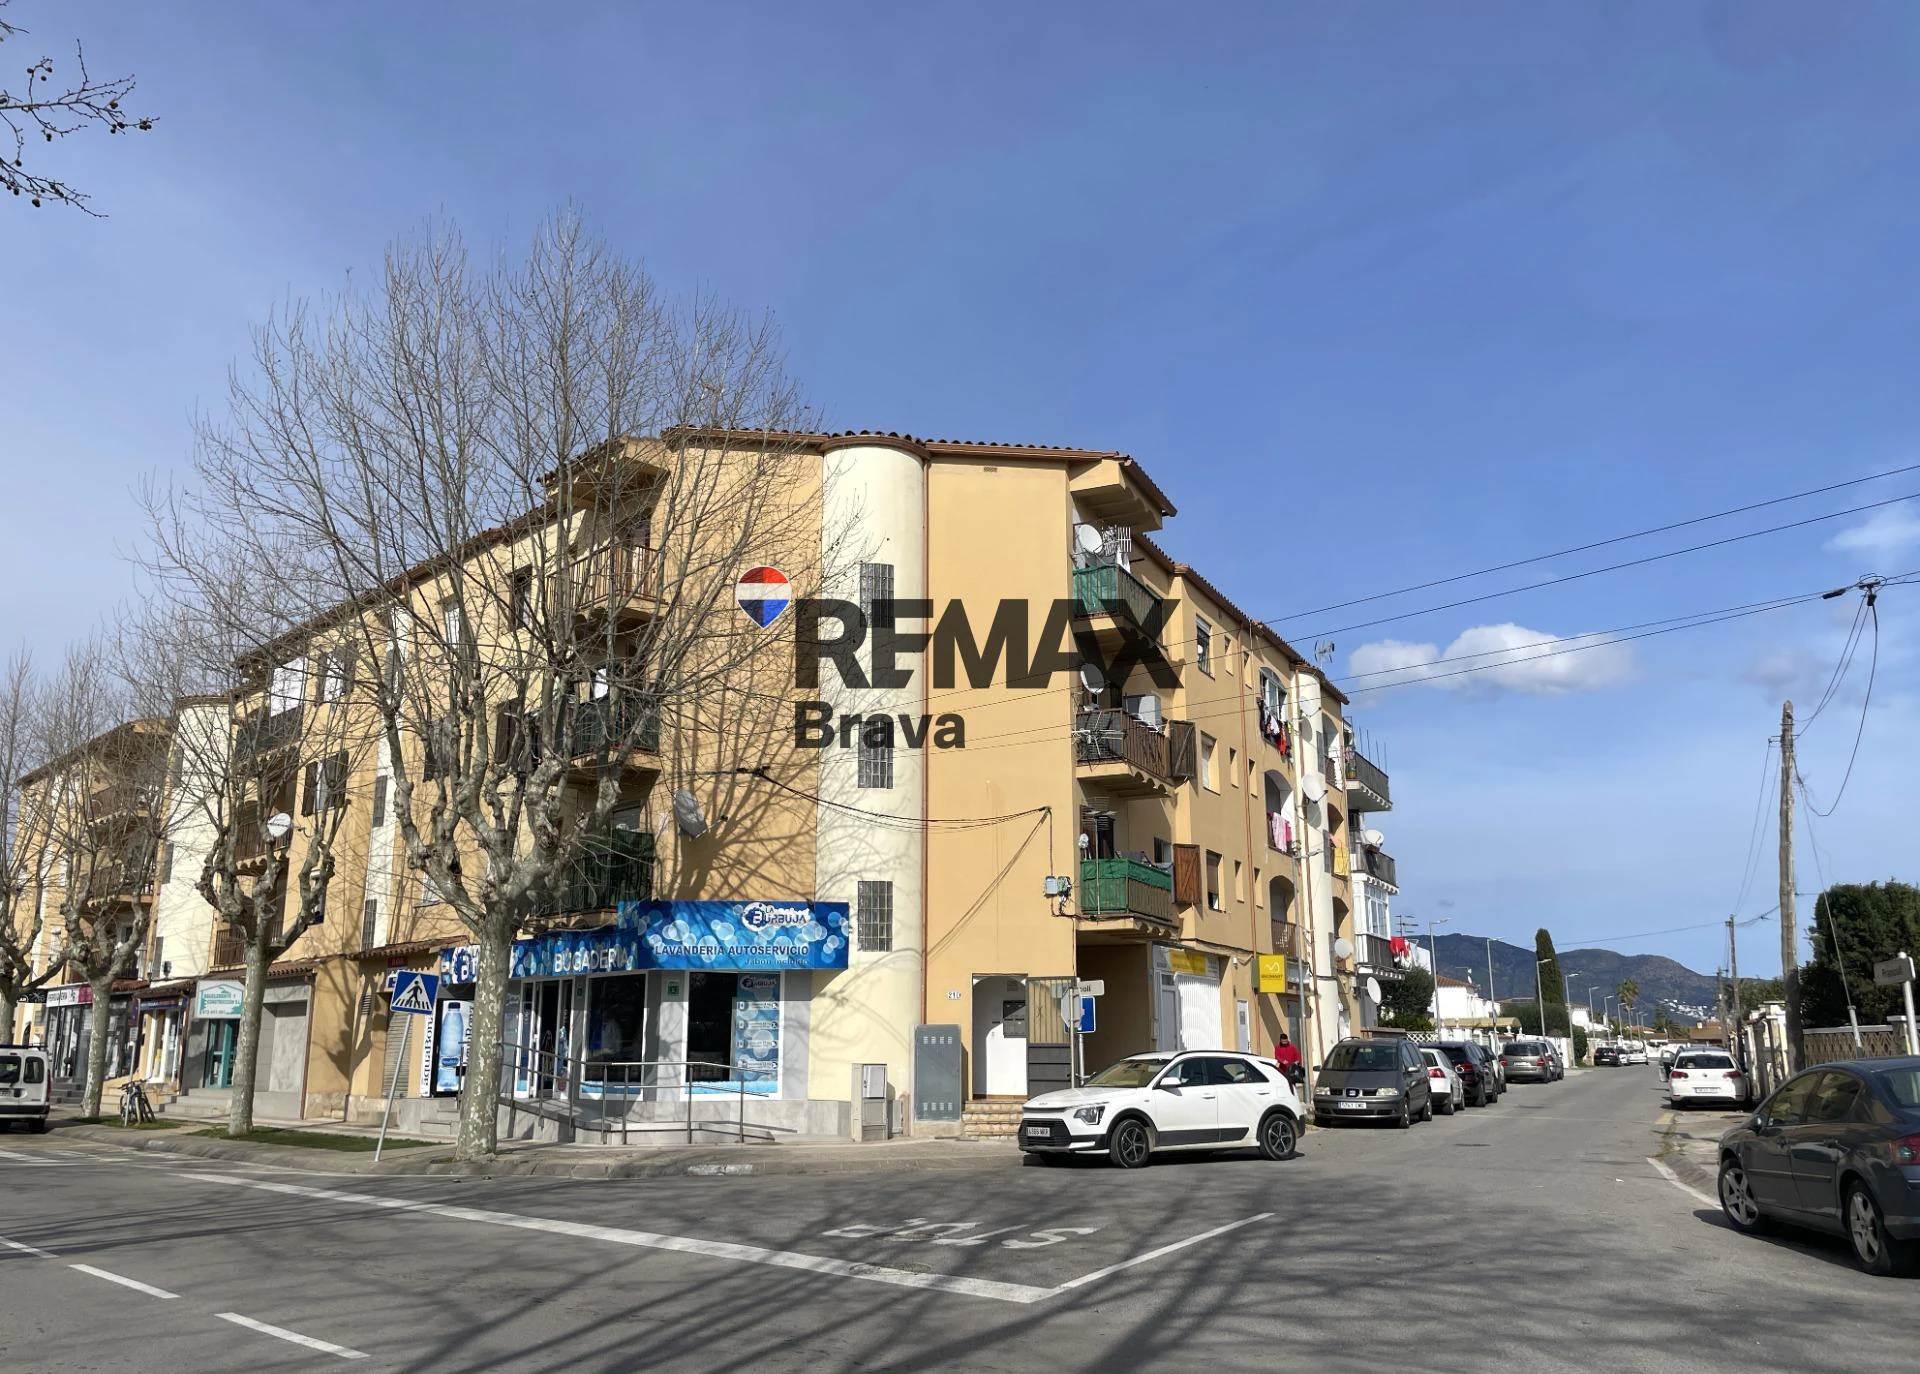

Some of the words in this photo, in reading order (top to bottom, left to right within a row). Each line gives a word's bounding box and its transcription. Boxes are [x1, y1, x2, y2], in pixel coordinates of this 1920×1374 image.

[554, 946, 628, 973] BUGADERIA
[655, 944, 725, 957] LAVANDERIA
[727, 944, 809, 956] AUTOSERVICIO
